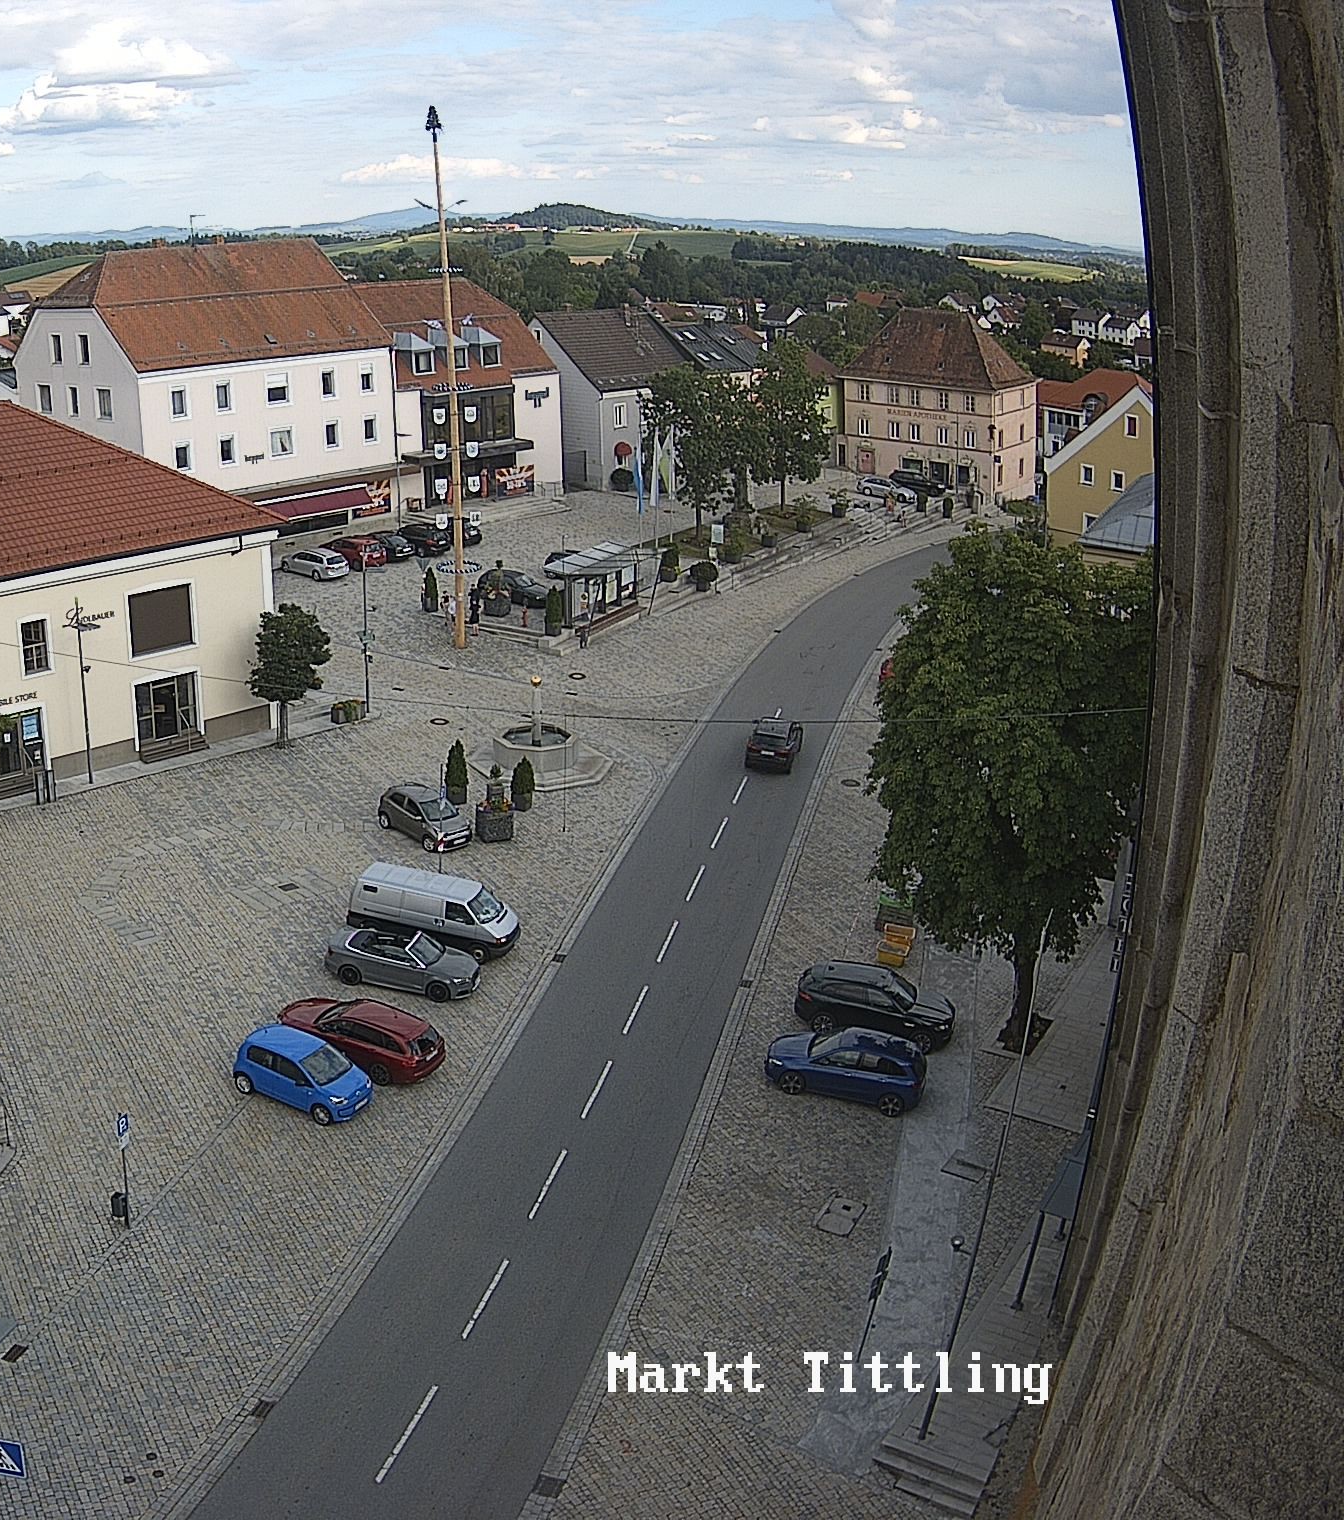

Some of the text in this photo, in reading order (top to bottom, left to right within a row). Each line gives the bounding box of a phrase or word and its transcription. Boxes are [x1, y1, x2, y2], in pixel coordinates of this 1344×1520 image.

[887, 407, 948, 421] MARIEN APOTHEKE
[14, 691, 38, 704] STORE
